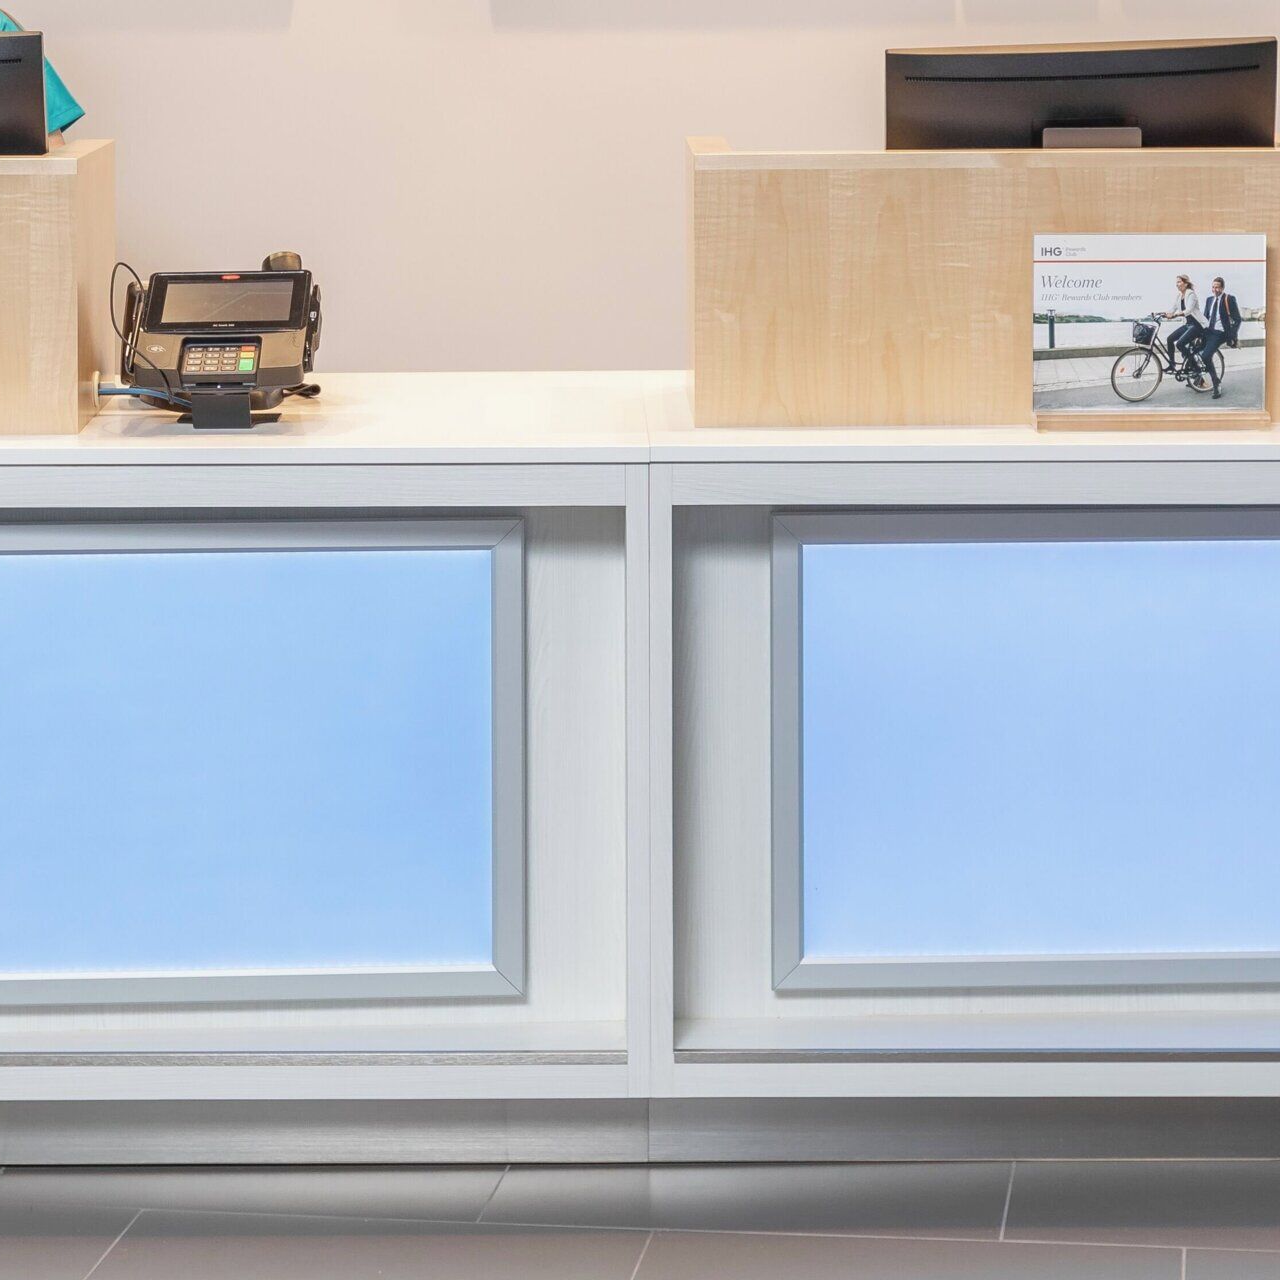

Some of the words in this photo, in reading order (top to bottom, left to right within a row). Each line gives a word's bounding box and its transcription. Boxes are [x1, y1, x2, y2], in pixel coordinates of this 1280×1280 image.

[1040, 246, 1063, 257] IHG
[1041, 275, 1103, 289] Welcome
[1061, 293, 1092, 302] Rewards
[1092, 293, 1110, 302] Club
